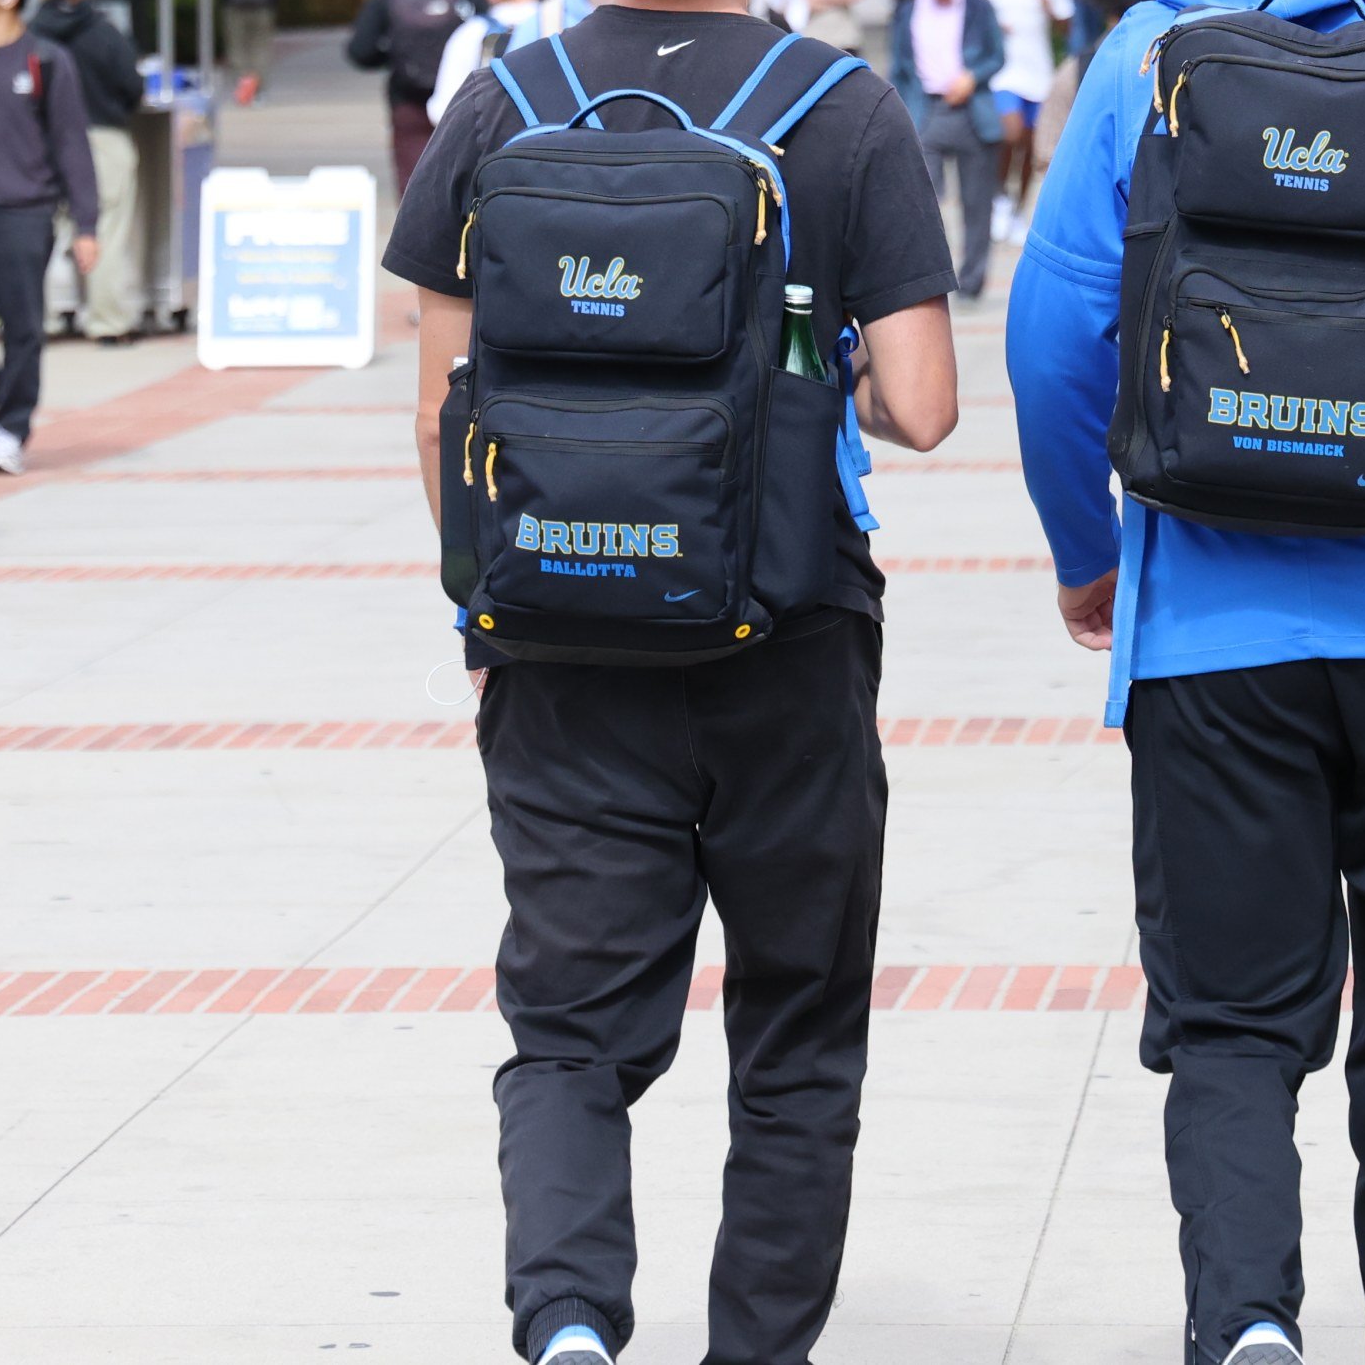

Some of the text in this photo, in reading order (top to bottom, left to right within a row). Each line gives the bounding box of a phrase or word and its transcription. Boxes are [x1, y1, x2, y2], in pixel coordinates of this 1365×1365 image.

[1262, 126, 1348, 174] Ucla
[1274, 173, 1330, 192] TENNIS
[558, 255, 641, 300] Ucla
[570, 300, 625, 317] TENNIS
[1233, 435, 1345, 458] VON BISMARCK
[515, 512, 679, 558] BRUINS
[540, 558, 637, 578] BALLOTTA
